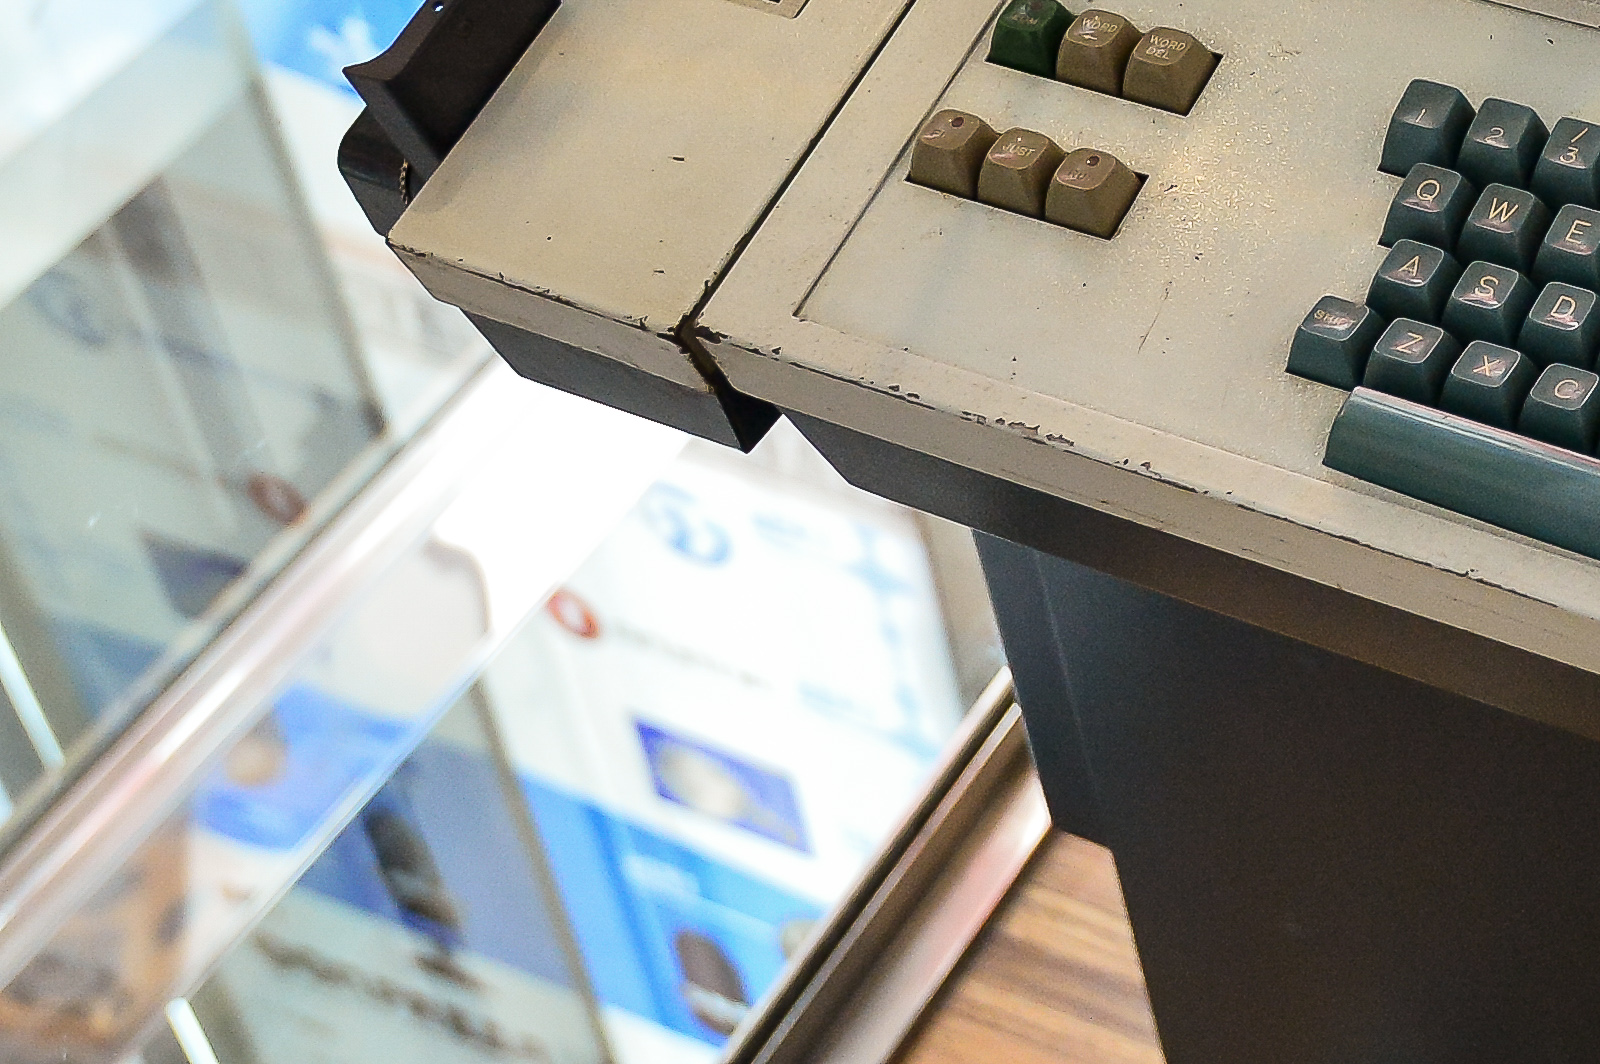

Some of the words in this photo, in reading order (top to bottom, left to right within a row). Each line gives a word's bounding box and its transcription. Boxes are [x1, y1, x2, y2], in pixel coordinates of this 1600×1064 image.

[1081, 17, 1118, 34] WORD
[1146, 47, 1169, 60] DEL
[1149, 35, 1186, 52] WORD
[1483, 126, 1505, 143] 2
[1003, 142, 1035, 157] JUST
[1559, 146, 1579, 164] 3
[1416, 178, 1441, 203] Q
[1489, 198, 1518, 222] W
[1566, 220, 1590, 244] E
[1398, 255, 1422, 277] A
[1474, 275, 1497, 296] S
[1550, 295, 1577, 318] D
[1393, 332, 1425, 354] Z
[1475, 355, 1504, 377] X
[1553, 379, 1579, 400] C
